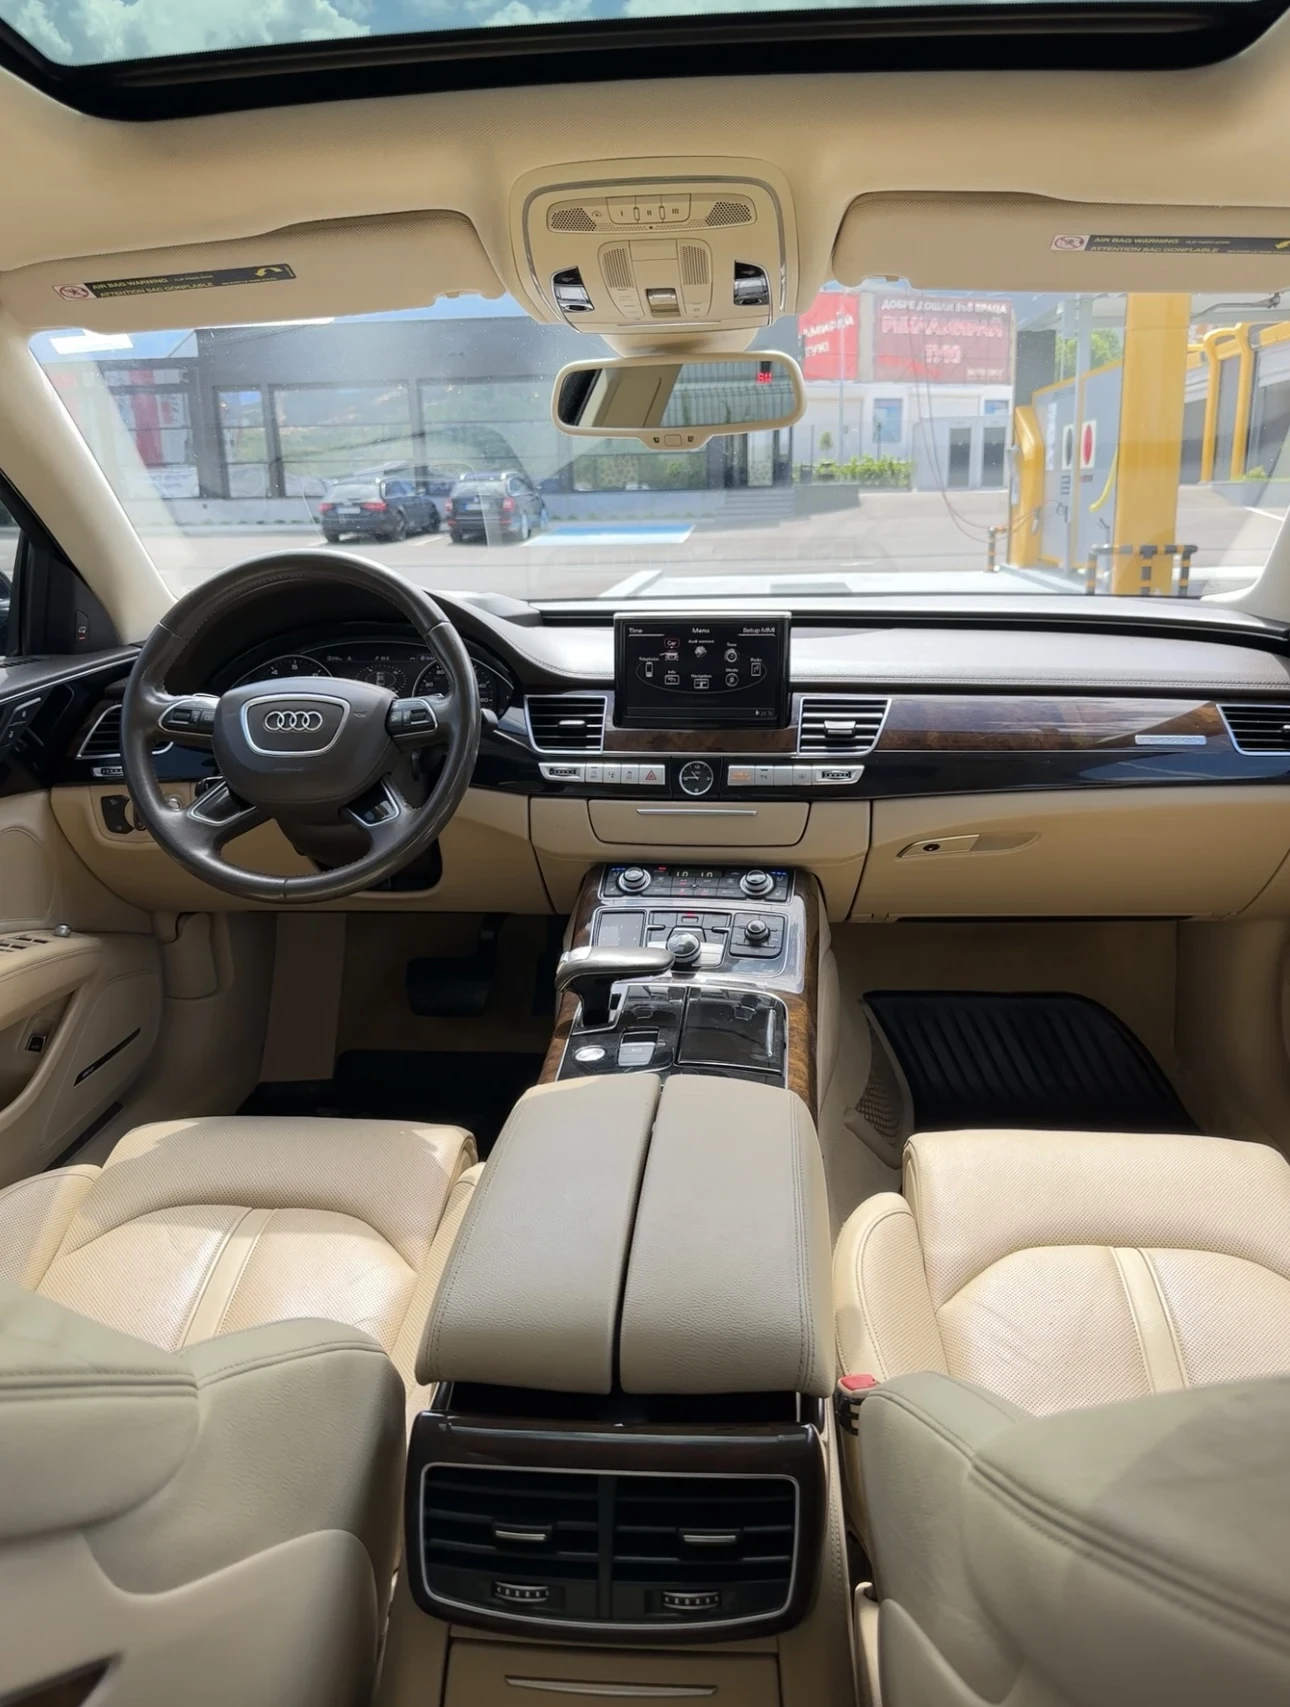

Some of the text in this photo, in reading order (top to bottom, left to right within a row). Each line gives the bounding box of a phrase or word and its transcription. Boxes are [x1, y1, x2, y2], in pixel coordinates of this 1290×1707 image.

[92, 282, 107, 290] AIR
[127, 278, 168, 286] WARNING
[100, 287, 146, 297] ATTENTION
[881, 300, 916, 311] ДОБРЕ
